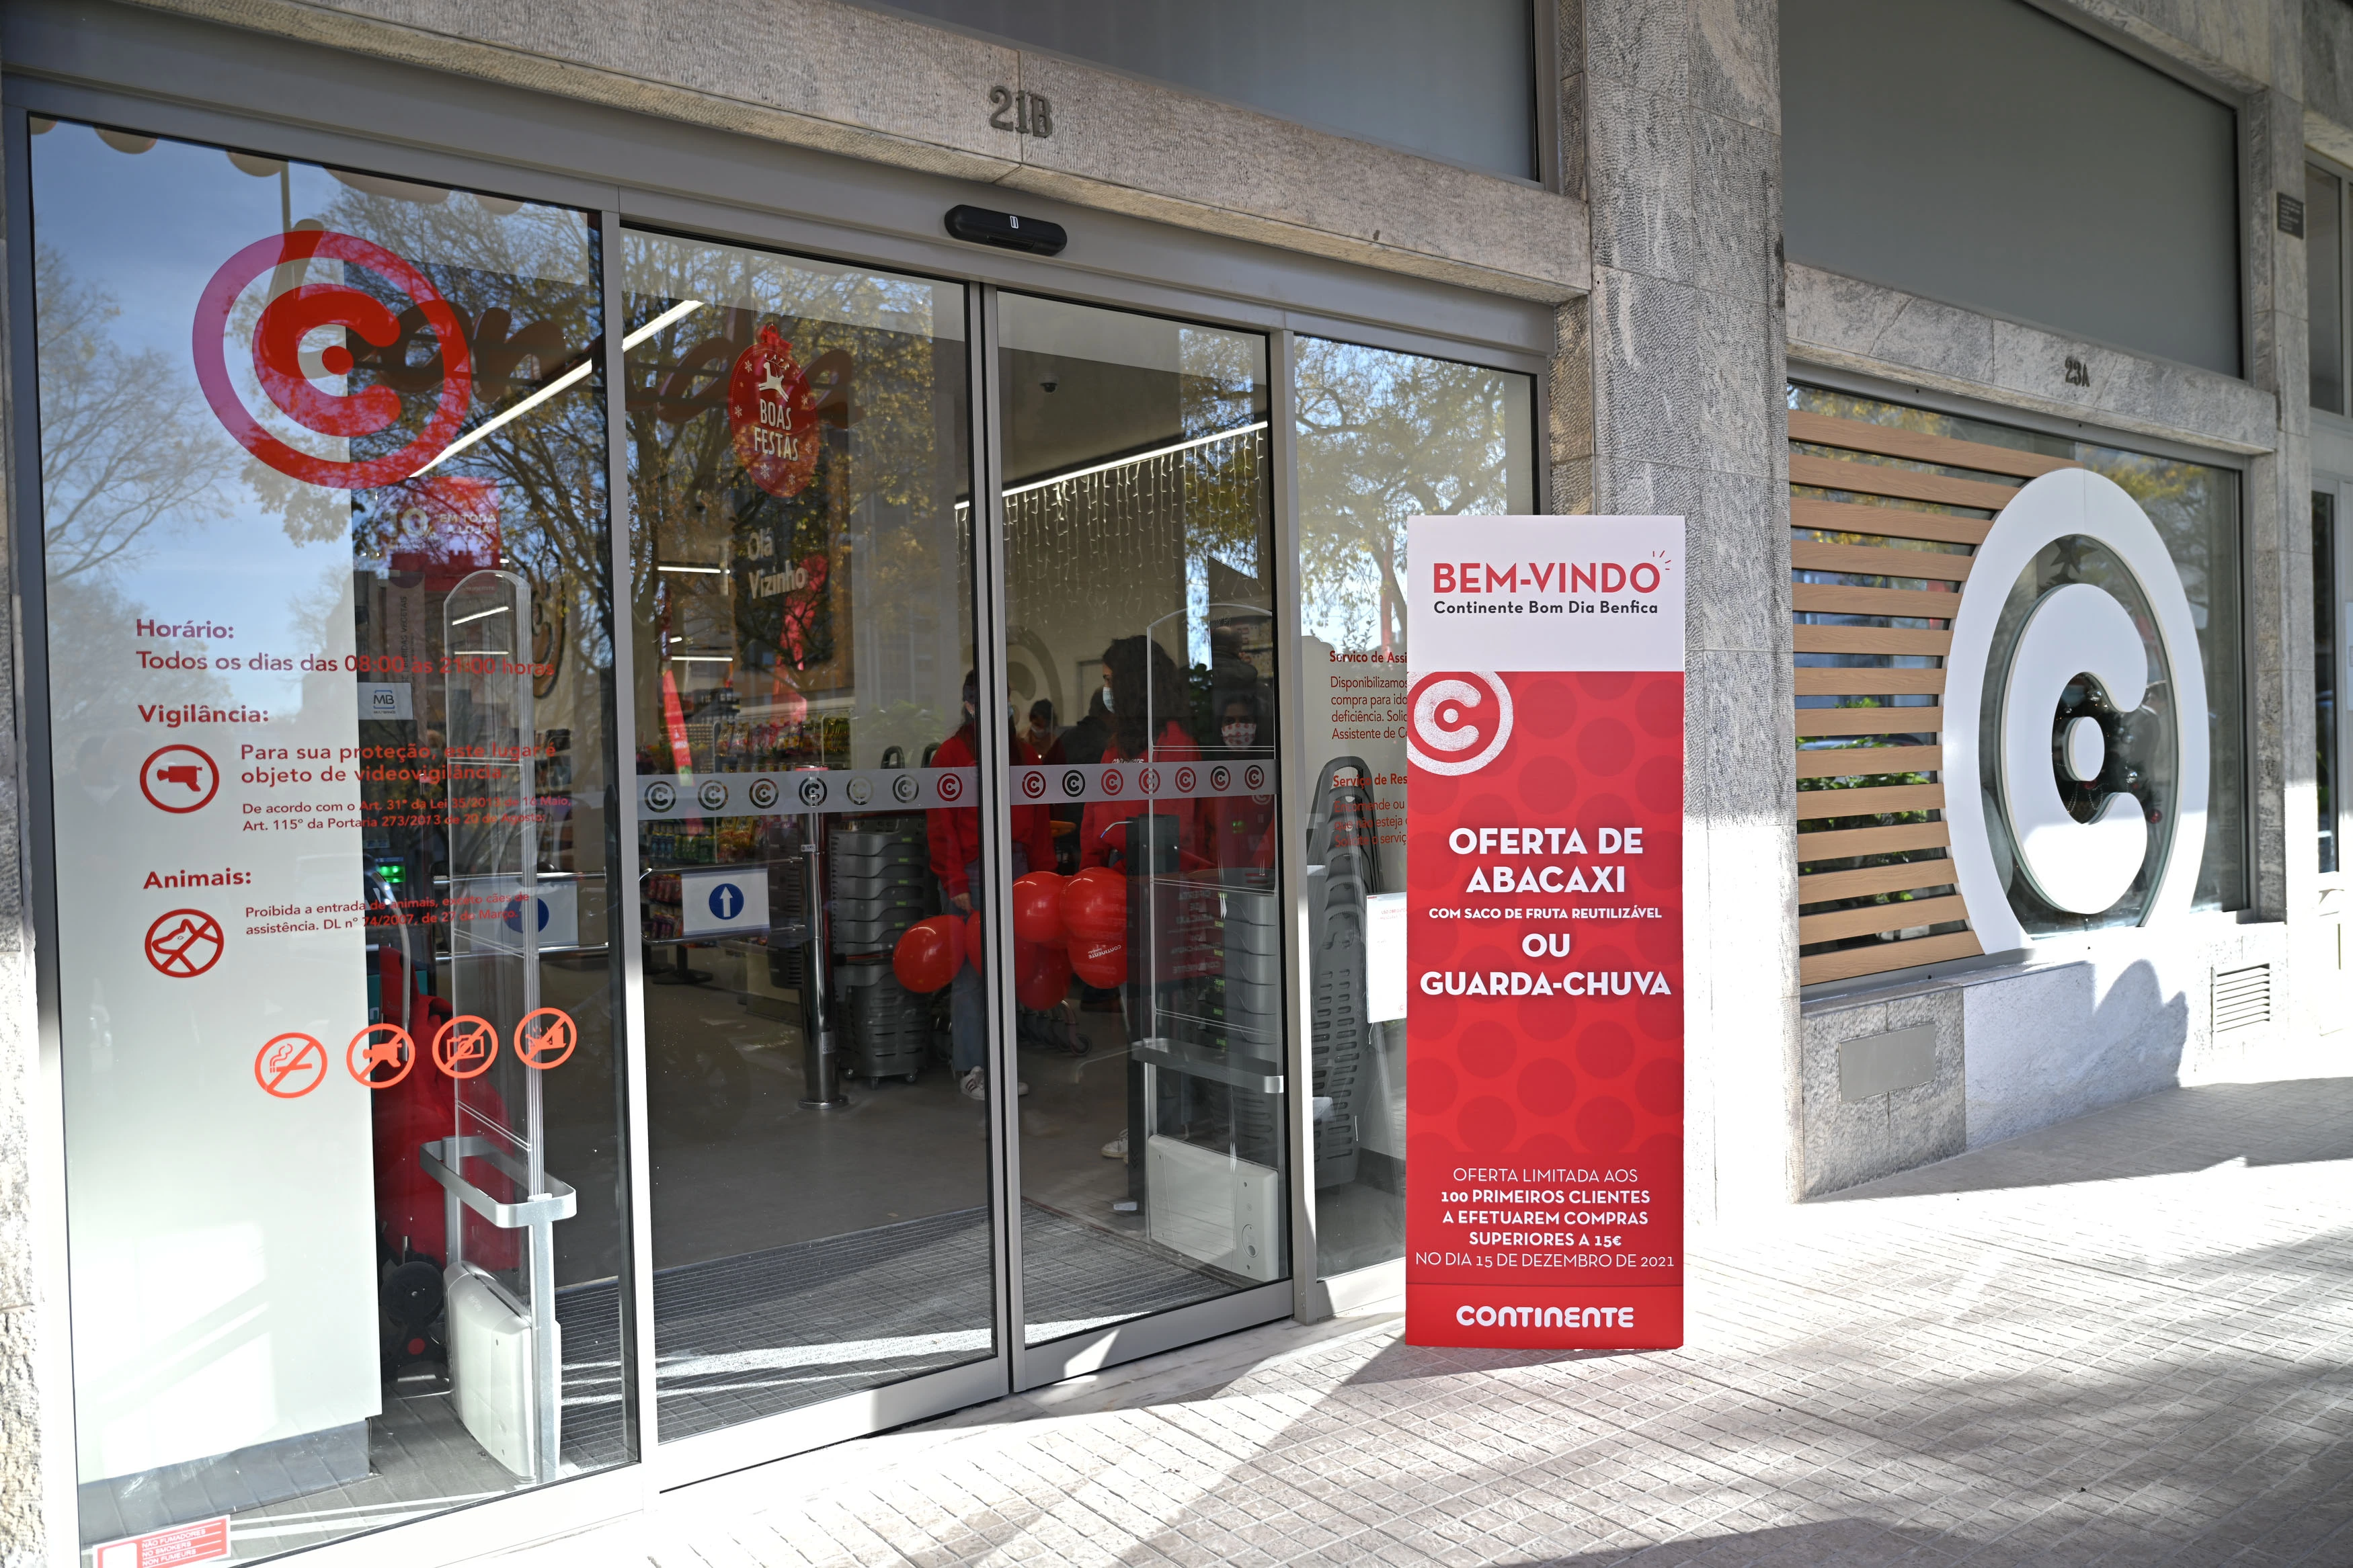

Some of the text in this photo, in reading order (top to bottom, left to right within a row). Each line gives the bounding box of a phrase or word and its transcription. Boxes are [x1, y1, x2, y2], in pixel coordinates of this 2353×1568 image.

[990, 85, 1053, 138] 21B
[2065, 356, 2090, 388] 23A
[760, 398, 793, 431] BOAS
[754, 426, 799, 462] FESTAS
[747, 526, 774, 561] Olá
[749, 561, 807, 600] Vizinho
[1433, 562, 1661, 594] BEM-VINDO
[1434, 600, 1659, 614] Continente Bom Dia Benfica
[136, 619, 234, 638] Horário:
[136, 651, 555, 675] Todos os dias das 08:00 às 21:00 horas
[1371, 651, 1384, 663] de
[373, 694, 395, 704] MB
[1331, 696, 1367, 709] compra
[1370, 696, 1391, 709] para
[138, 704, 269, 728] Vigilância:
[1332, 709, 1384, 722] deficiência.
[1332, 727, 1381, 739] Assistente
[1384, 727, 1396, 739] de
[241, 741, 556, 763] Para sua proteção, este lugar é
[241, 764, 507, 788] objeto de videovigilância.
[1333, 774, 1371, 790] Serviço
[1374, 773, 1387, 785] de
[243, 803, 262, 814] De
[266, 802, 311, 813] acordo
[316, 803, 343, 812] com
[347, 803, 355, 811] o
[360, 800, 383, 811] Art.
[411, 798, 426, 809] da
[430, 798, 448, 809] Lei
[452, 797, 500, 808] 35/2013
[505, 796, 519, 807] de
[523, 796, 537, 807] 16
[540, 796, 571, 807] Maio,
[1334, 798, 1404, 813] Encomende ou
[243, 821, 268, 831] Art.
[307, 819, 323, 829] da
[328, 816, 378, 828] Portaria
[381, 815, 441, 827] 273/2013
[444, 813, 460, 825] de
[464, 813, 479, 824] 20
[482, 813, 497, 823] de
[501, 813, 546, 825] Agosto;
[1334, 820, 1353, 832] que
[1357, 817, 1373, 828] não
[1376, 815, 1403, 829] esteja
[1334, 834, 1369, 847] Solicite
[1372, 836, 1378, 844] o
[1448, 827, 1643, 855] OFERTA DE
[144, 868, 251, 890] Animais:
[1466, 866, 1625, 893] ABACAXI
[245, 905, 301, 917] Proibida
[316, 900, 366, 913] entrada
[370, 899, 386, 910] de
[389, 897, 439, 909] animais,
[442, 896, 483, 907] exceto
[486, 893, 512, 903] cães
[515, 892, 530, 901] de
[1429, 905, 1662, 919] COM SACO DE FRUTA REUTILIZÁVEL
[246, 922, 319, 936] assistência.
[323, 919, 342, 930] DL
[362, 913, 417, 927] 74/2007,
[422, 912, 438, 923] de
[442, 911, 456, 922] 27
[459, 910, 475, 921] de
[479, 909, 519, 921] Março.
[1088, 944, 1121, 959] CONTINENTE
[1521, 933, 1570, 958] OU
[1420, 971, 1671, 996] GUARDA-CHUVA
[1453, 1167, 1638, 1183] OFERTA LIMITADA AOS
[1441, 1190, 1650, 1204] 100 PRIMEIROS CLIENTES
[1442, 1211, 1648, 1225] A EFETUAREM COMPRAS
[1469, 1232, 1622, 1247] SUPERIORES A 15€
[1415, 1251, 1674, 1268] NO DIA 15 DE DEZEMBRO DE 2021
[1456, 1305, 1634, 1328] CONTINENTE
[142, 1528, 206, 1549] NÃO FUMADORES
[142, 1540, 192, 1557] NO SMOKERS
[142, 1548, 197, 1567] NON FUMEURS
